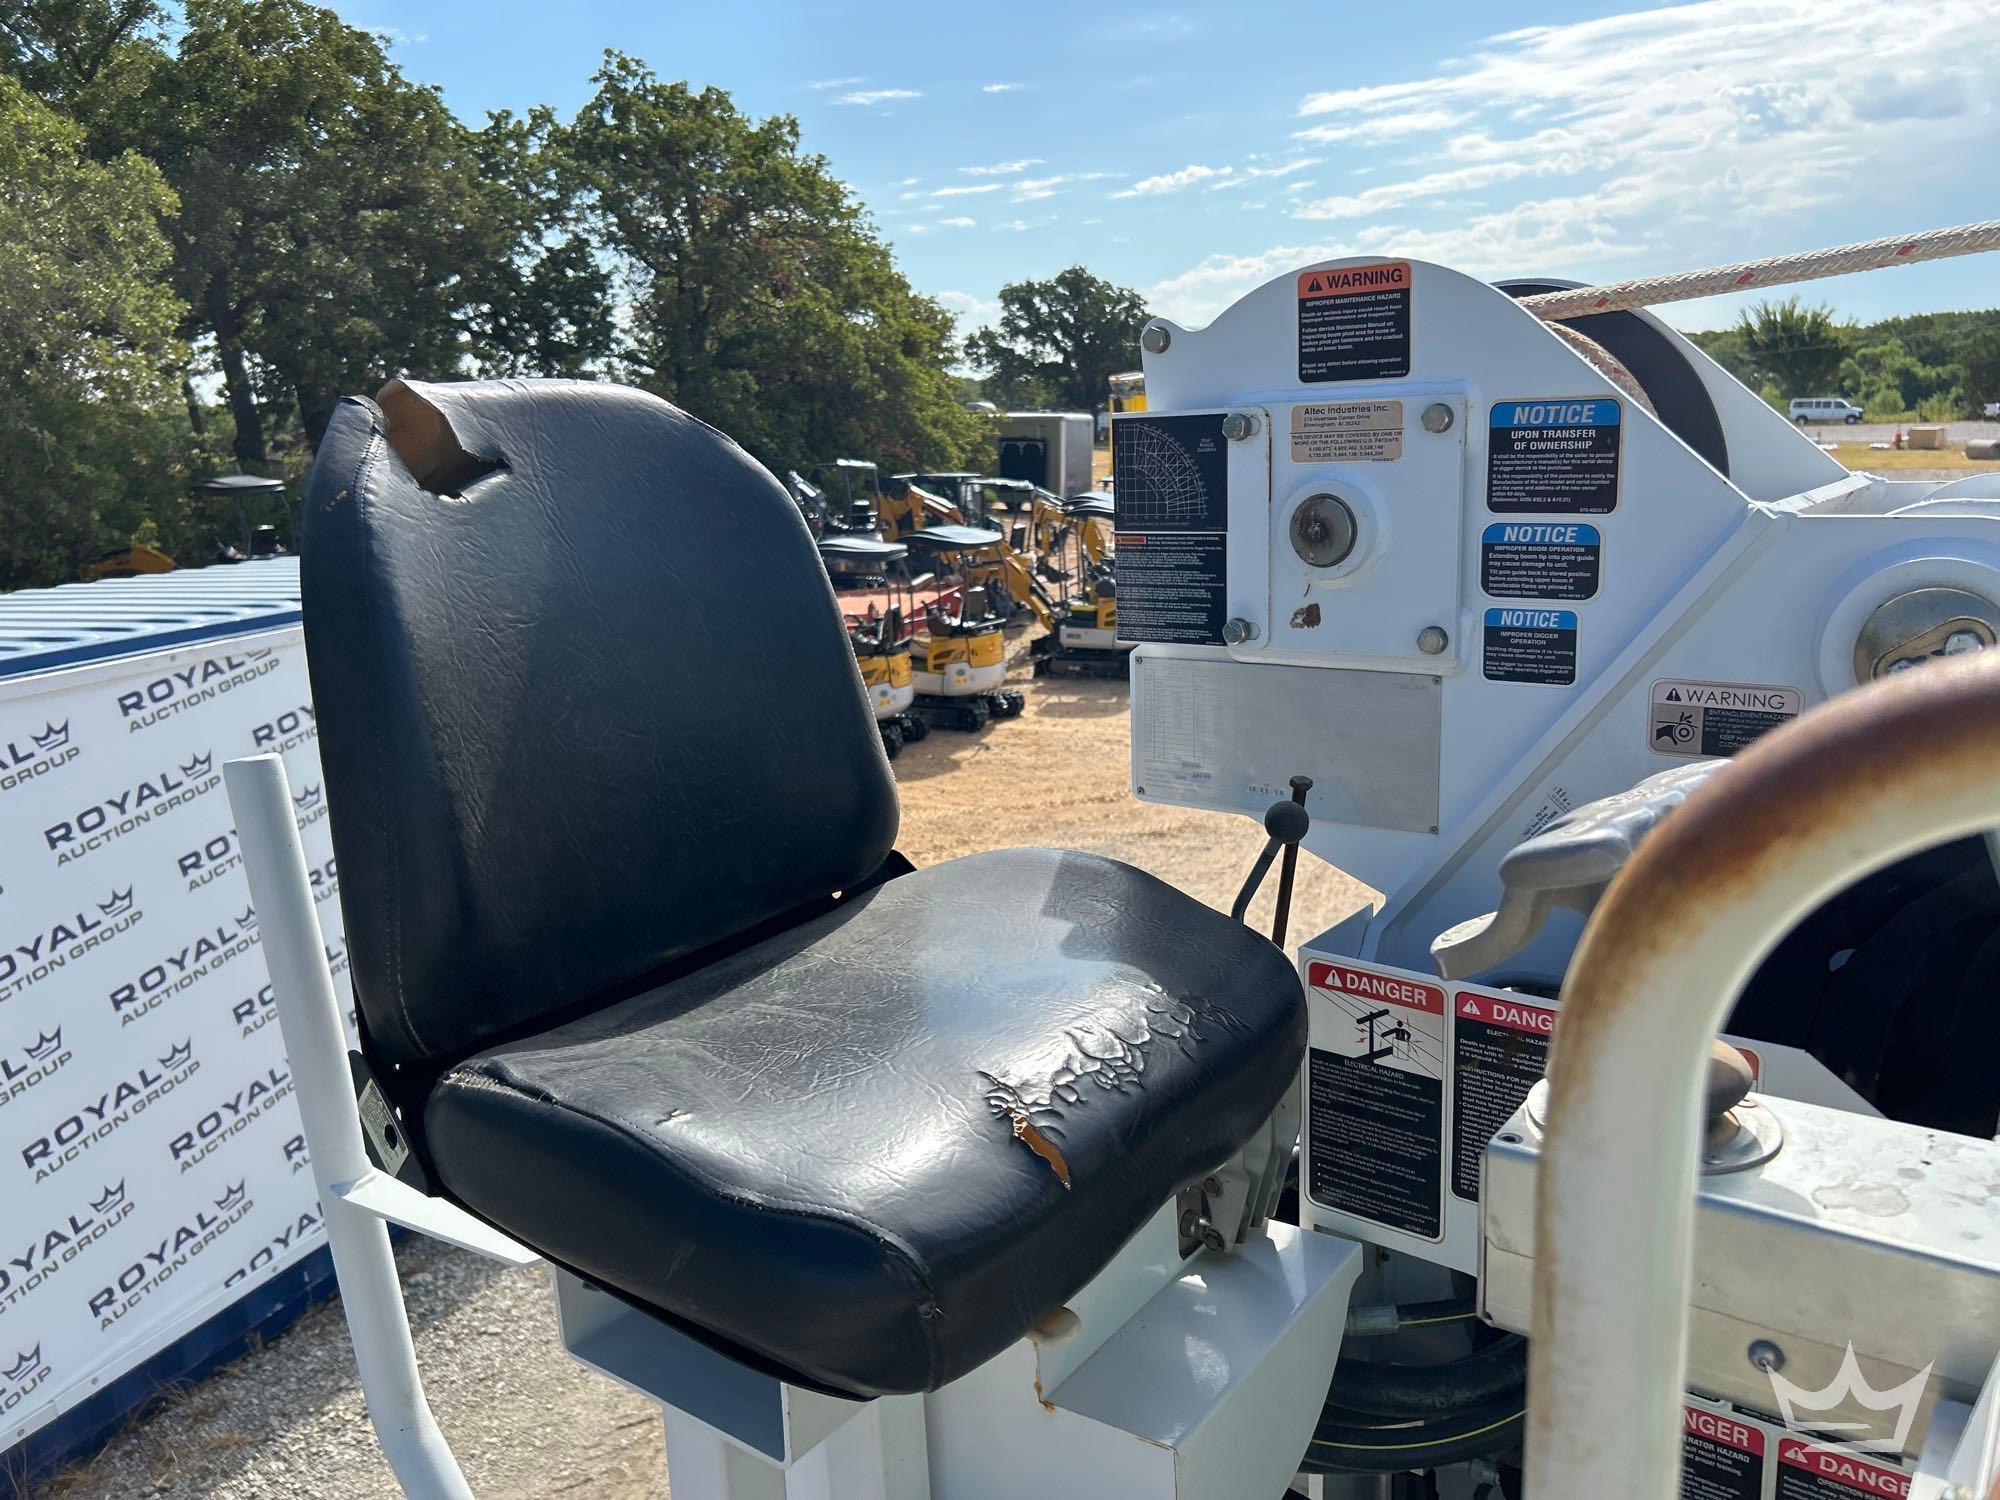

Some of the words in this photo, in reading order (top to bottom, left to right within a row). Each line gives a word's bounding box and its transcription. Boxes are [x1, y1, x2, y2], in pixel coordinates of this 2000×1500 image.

[1327, 269, 1403, 289] WARNING
[1306, 298, 1335, 307] IMPROPER
[1335, 295, 1376, 304] MAINTENANCE
[1304, 407, 1325, 415] Altec
[1328, 405, 1371, 414] Industries
[1374, 404, 1389, 412] Inc.
[1513, 405, 1596, 424] NOTICE
[1511, 430, 1539, 439] UPON
[1542, 430, 1596, 438] TRANSFER
[1514, 442, 1527, 450] OF
[1530, 441, 1593, 450] OWNERSHIP
[1503, 526, 1578, 542] NOTICE
[1501, 611, 1560, 628] NOTICE
[116, 655, 246, 718] ROYAL
[129, 687, 217, 733] AUCTION
[219, 658, 280, 694] GROUP
[1686, 689, 1785, 710] WARNING
[252, 705, 316, 747] ROY
[1709, 709, 1761, 719] ENTANGLEMENT
[1, 747, 80, 790] GROUP
[44, 772, 183, 851] ROYAL
[57, 811, 151, 868] AUCTION
[153, 775, 221, 817] GROUP
[296, 803, 328, 832] OUP
[188, 854, 242, 893] AUCTI
[0, 913, 101, 982] OYAL
[0, 954, 66, 1002] CTION
[69, 910, 143, 960] GROUP
[109, 927, 238, 1012] ROYAL
[121, 965, 209, 1028] AUCTION
[211, 930, 261, 971] GROU
[1346, 973, 1427, 1006] DANGER
[1493, 1004, 1553, 1031] DANG
[1460, 1038, 1478, 1047] Death
[1460, 1045, 1483, 1054] contact
[1484, 1050, 1497, 1058] with
[1344, 1059, 1378, 1074] ELECTRICAL
[1379, 1068, 1404, 1079] HAZARD
[1461, 1064, 1505, 1080] INSTRUCTIONS
[1463, 1084, 1484, 1093] Extend
[1463, 1102, 1489, 1112] Consider
[21, 1069, 162, 1169] ROYAL
[35, 1111, 129, 1184] AUCTION
[132, 1060, 200, 1115] GROUP
[169, 1068, 289, 1160] ROYAL
[180, 1107, 261, 1174] AUCTION
[62, 1201, 135, 1263] GROUP
[88, 1212, 218, 1318] ROYAL
[100, 1254, 188, 1332] AUCTION
[190, 1199, 254, 1257] GROUP
[0, 1366, 51, 1413] OUP
[1683, 1409, 1749, 1447] NGER
[1684, 1436, 1715, 1451] ERATOR
[1717, 1447, 1750, 1463] HAZARD
[1820, 1456, 1910, 1496] DANGE
